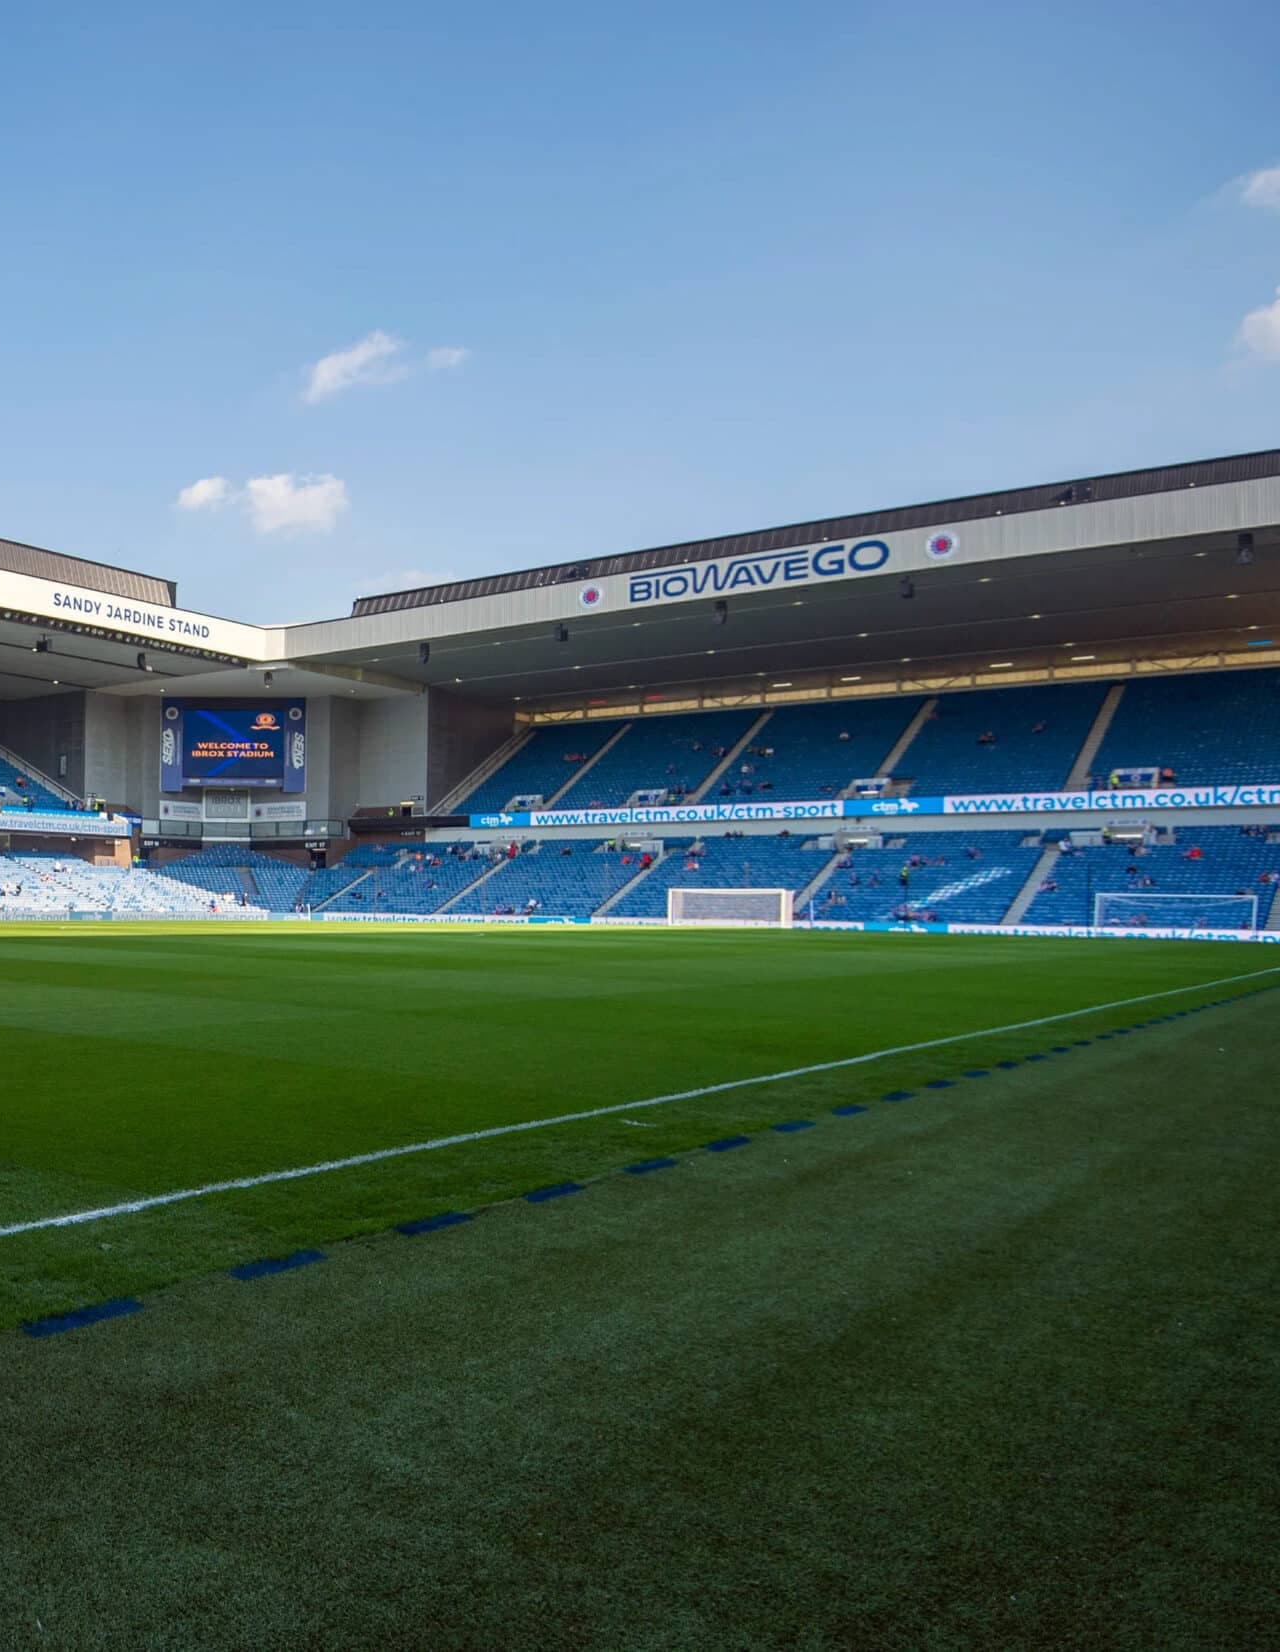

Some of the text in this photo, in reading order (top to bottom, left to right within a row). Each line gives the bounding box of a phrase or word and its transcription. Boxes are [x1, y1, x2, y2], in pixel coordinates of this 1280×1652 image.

[53, 592, 210, 639] SANDY JARDINE STAND
[198, 742, 269, 750] WELCOME TO
[191, 750, 274, 758] IBROX STADIUM
[871, 801, 899, 813] ctm
[536, 802, 837, 825] www.travelctm.co.uk/ctm-sport
[481, 814, 499, 825] ctm
